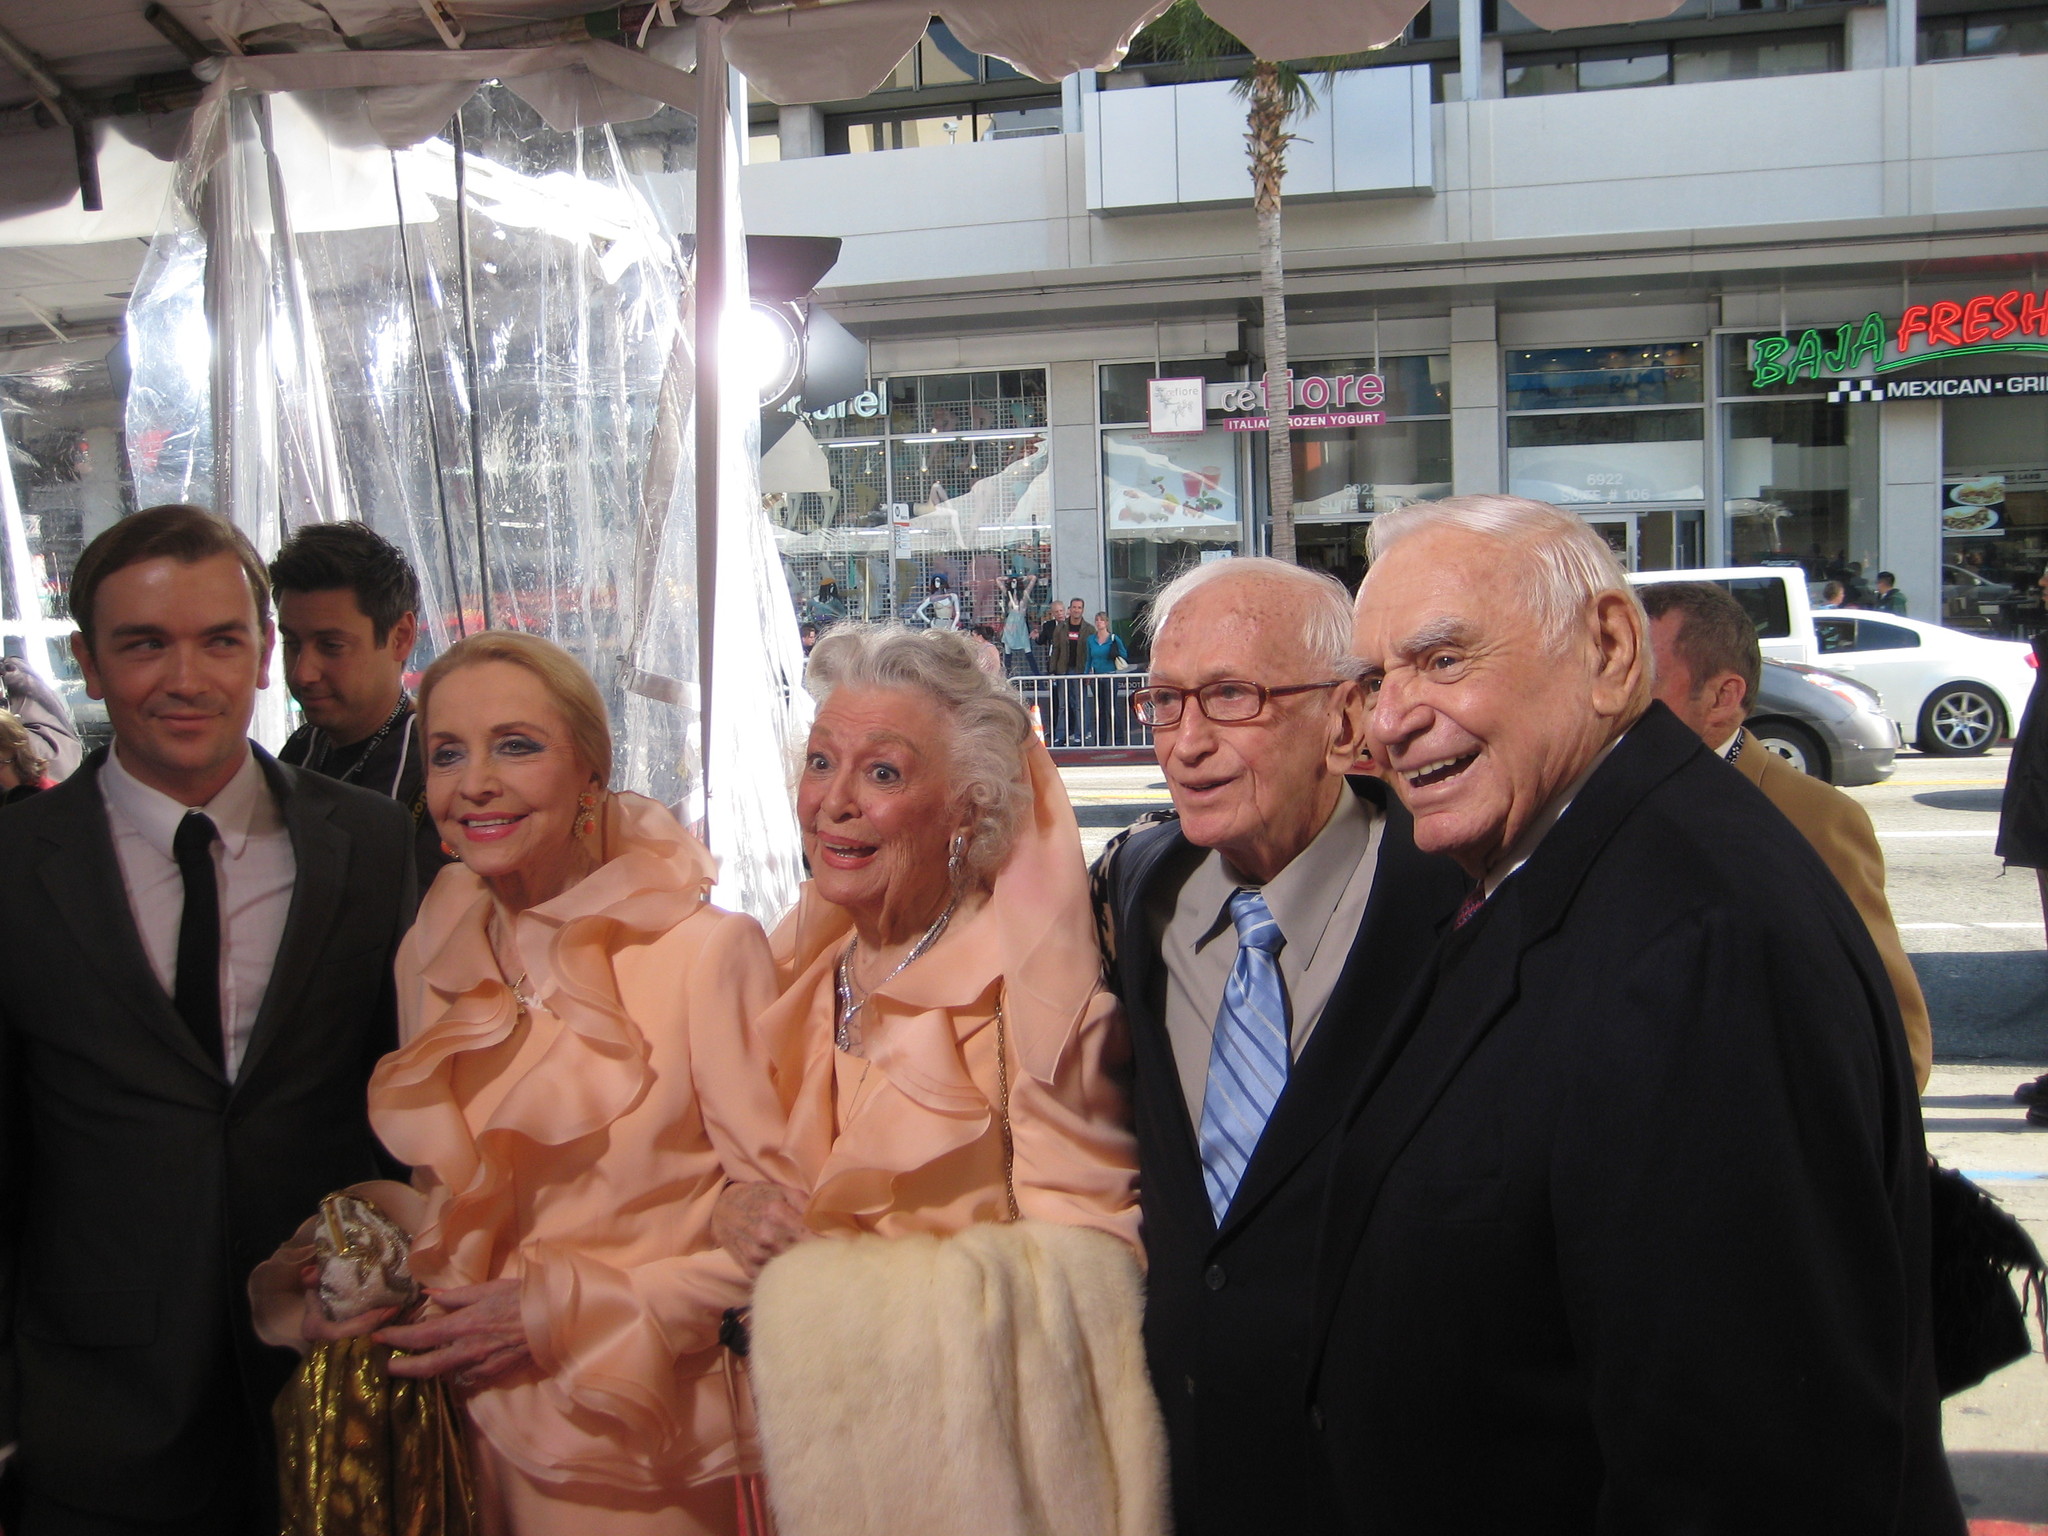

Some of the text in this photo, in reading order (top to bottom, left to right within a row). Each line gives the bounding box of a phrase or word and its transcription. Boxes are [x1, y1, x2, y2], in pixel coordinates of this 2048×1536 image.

[1752, 287, 2048, 388] BAJA FRESH
[1887, 378, 1992, 398] MEXICAN
[1287, 416, 1326, 427] ROZEN
[1330, 413, 1380, 425] YOGURT
[1587, 473, 1624, 486] 6922
